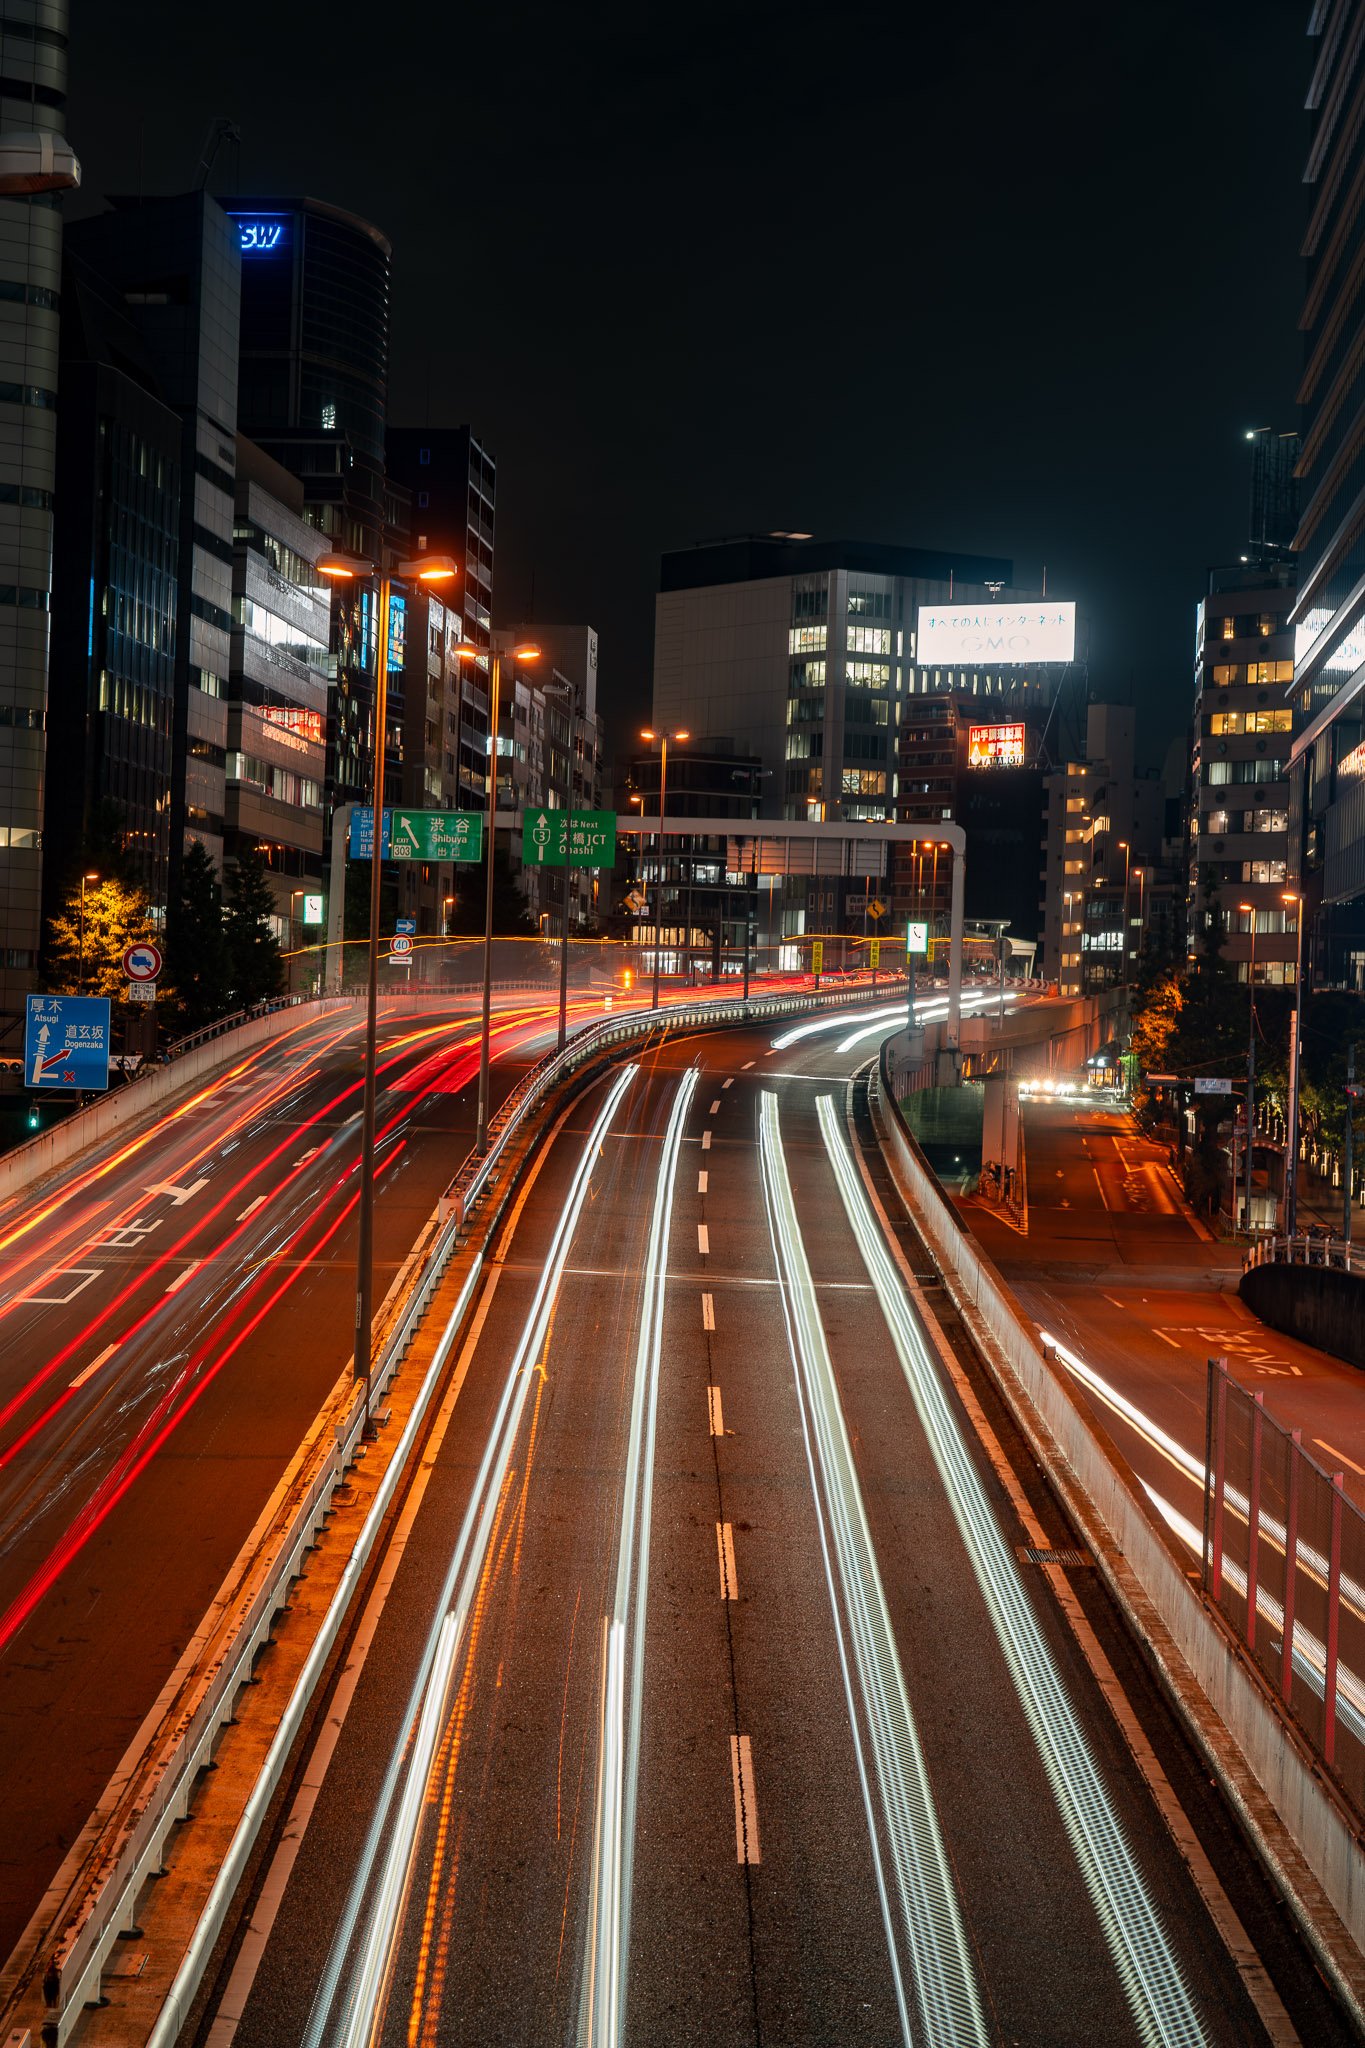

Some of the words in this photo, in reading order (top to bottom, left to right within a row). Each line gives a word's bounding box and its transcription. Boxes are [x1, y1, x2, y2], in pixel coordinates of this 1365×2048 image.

[960, 635, 1031, 651] GMO
[430, 817, 470, 833] 渋谷
[580, 821, 599, 829] Next
[360, 830, 389, 838] 山手り
[431, 833, 468, 845] Shibuya
[539, 831, 546, 842] 3
[394, 846, 411, 856] 303
[437, 847, 461, 857] 出口
[395, 940, 408, 950] 40
[31, 999, 62, 1013] 厚木
[34, 1014, 59, 1023] Atsugi
[65, 1025, 103, 1039] 道玄坂
[64, 1040, 103, 1049] Dogenzaka
